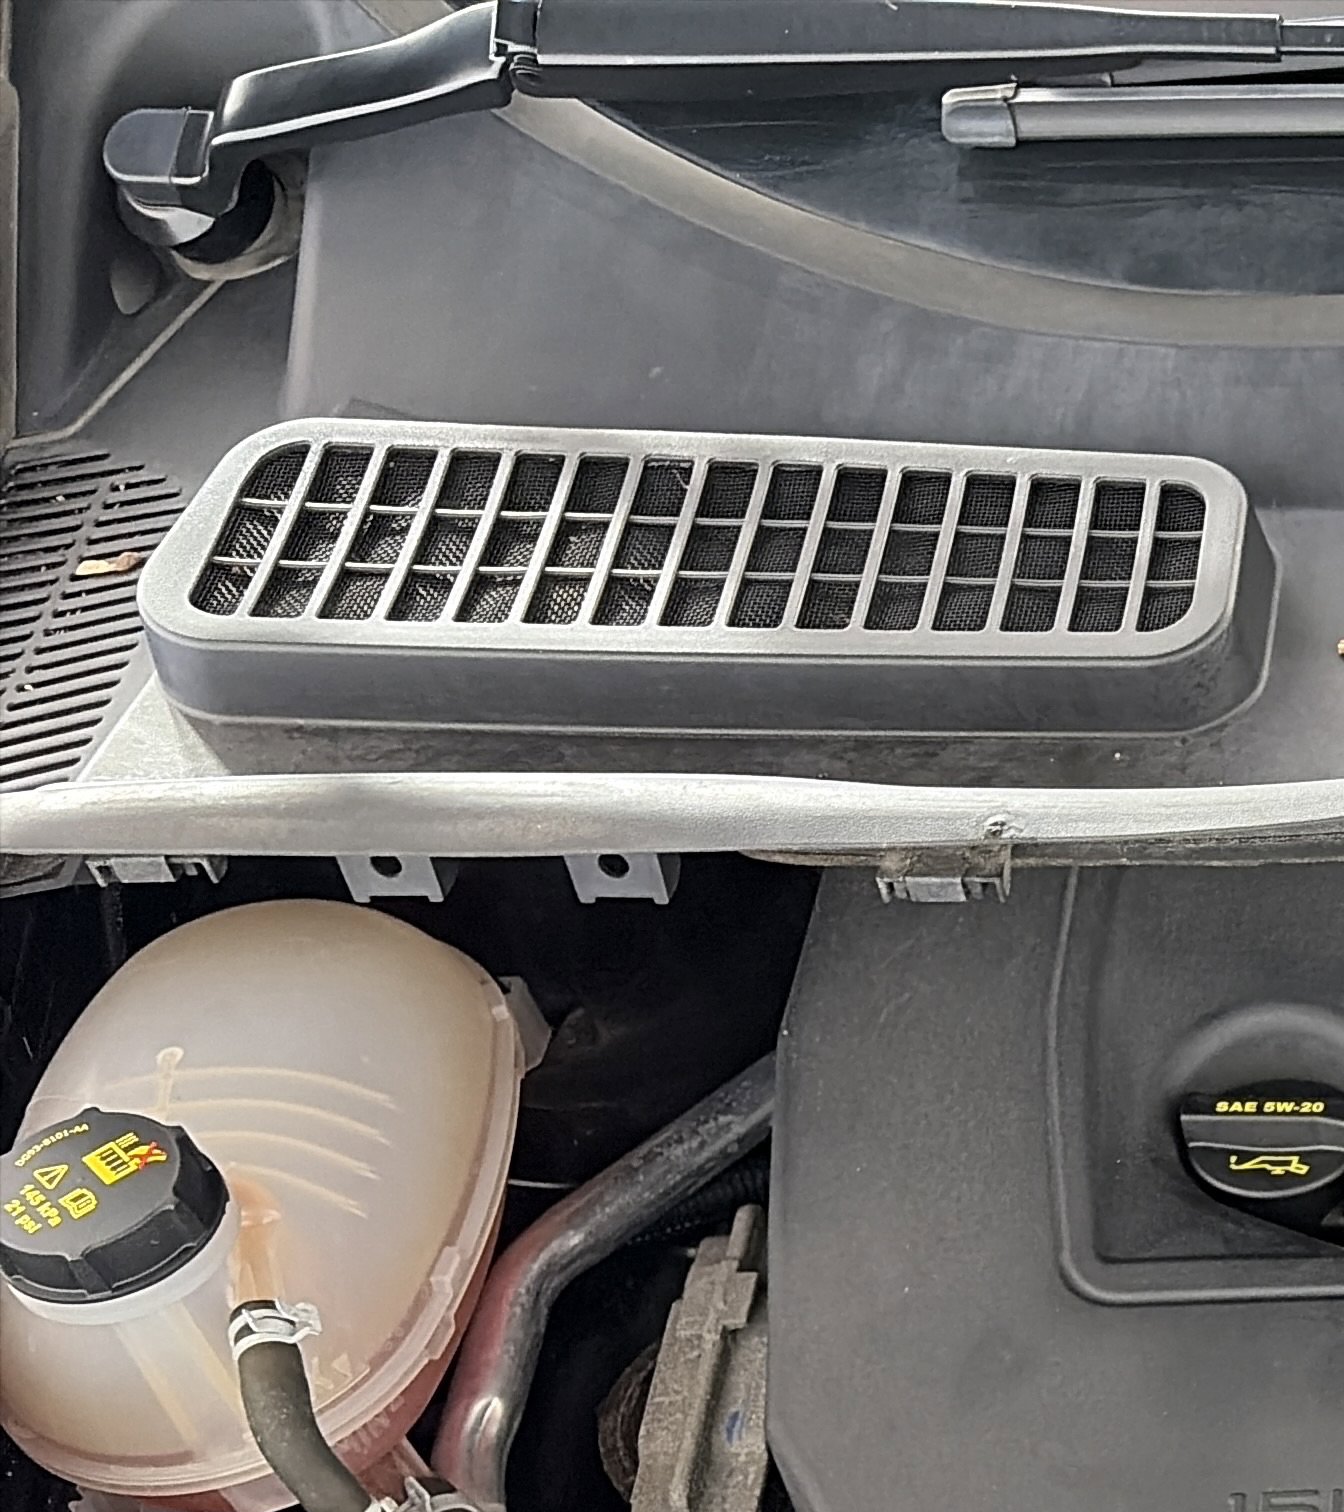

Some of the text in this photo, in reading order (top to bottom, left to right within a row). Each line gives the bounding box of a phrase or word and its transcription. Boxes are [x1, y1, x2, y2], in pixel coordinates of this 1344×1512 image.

[1214, 1100, 1325, 1114] SAE 5W-20
[4, 1199, 26, 1217] 21
[19, 1184, 62, 1227] 145 kPa
